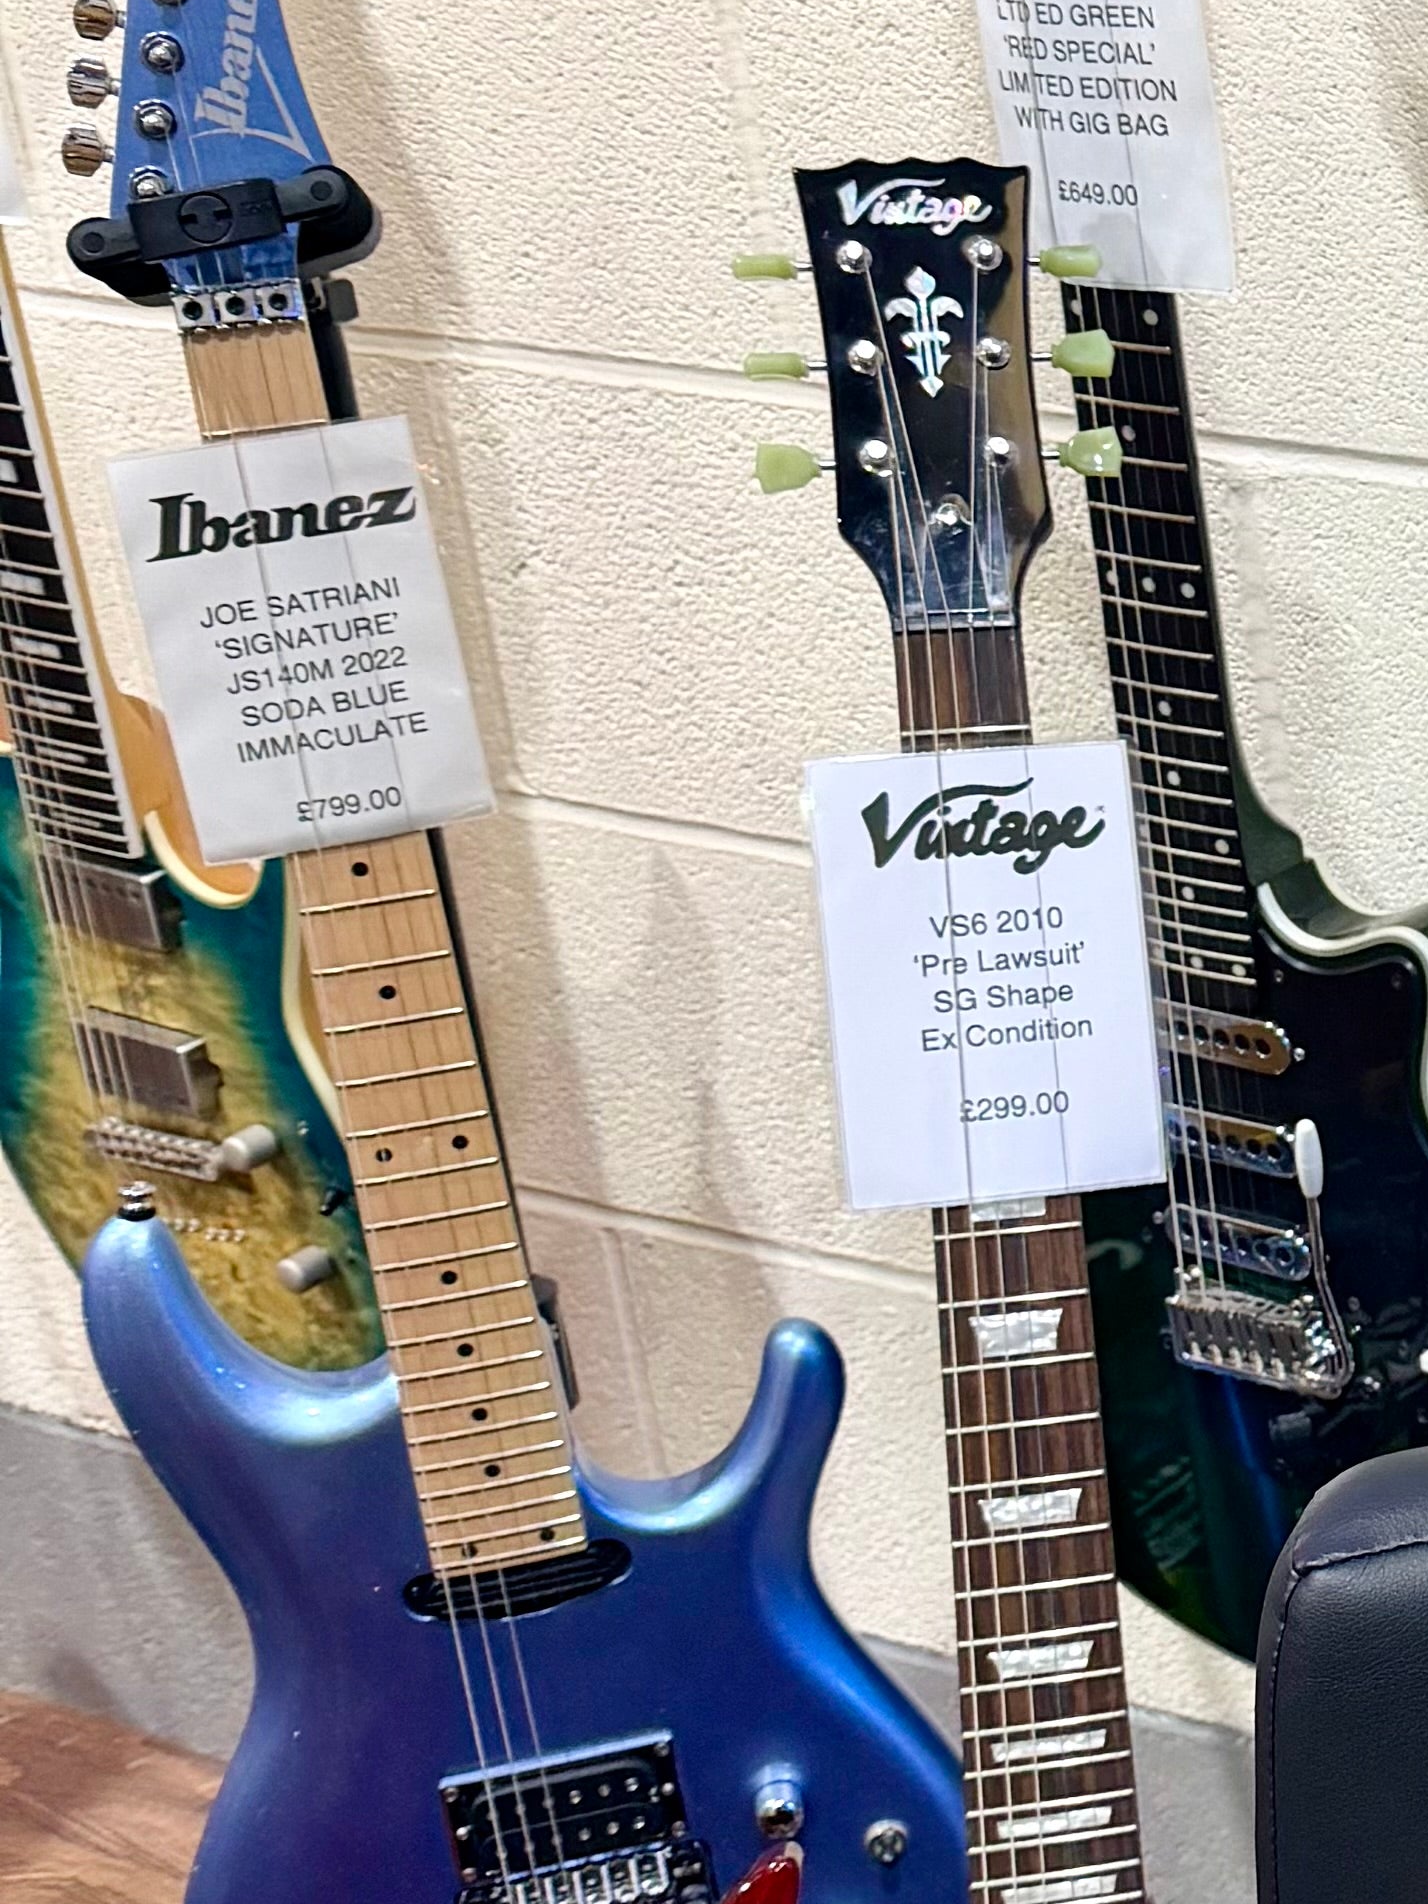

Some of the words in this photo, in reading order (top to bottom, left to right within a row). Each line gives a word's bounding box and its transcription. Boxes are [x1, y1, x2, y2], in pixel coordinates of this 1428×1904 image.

[1034, 2, 1063, 26] ED
[1069, 4, 1156, 28] GREEN
[997, 69, 1075, 98] LIMTED
[1079, 76, 1178, 102] EDITION
[1013, 105, 1065, 132] WITH
[1069, 111, 1111, 135] GIG
[1117, 113, 1170, 137] BAG
[835, 178, 993, 236] Vintage
[1058, 180, 1139, 207] £649.00
[145, 485, 417, 563] Ibanez
[200, 598, 258, 629] JOE
[267, 576, 401, 618] SATRIANI
[227, 658, 334, 696] JS140M
[342, 645, 409, 674] 2022
[242, 697, 327, 728] SODA
[335, 680, 409, 714] BLUE
[238, 710, 429, 764] IMMACULATE
[297, 785, 403, 823] £799.00
[861, 776, 1105, 874] Vintage
[929, 912, 988, 939] VS6
[996, 906, 1063, 935] 2010
[934, 990, 977, 1014] SG
[987, 983, 1074, 1011] Shape
[921, 1029, 959, 1053] Ex
[965, 1016, 1094, 1049] Condition
[959, 1090, 1070, 1123] £299.00
